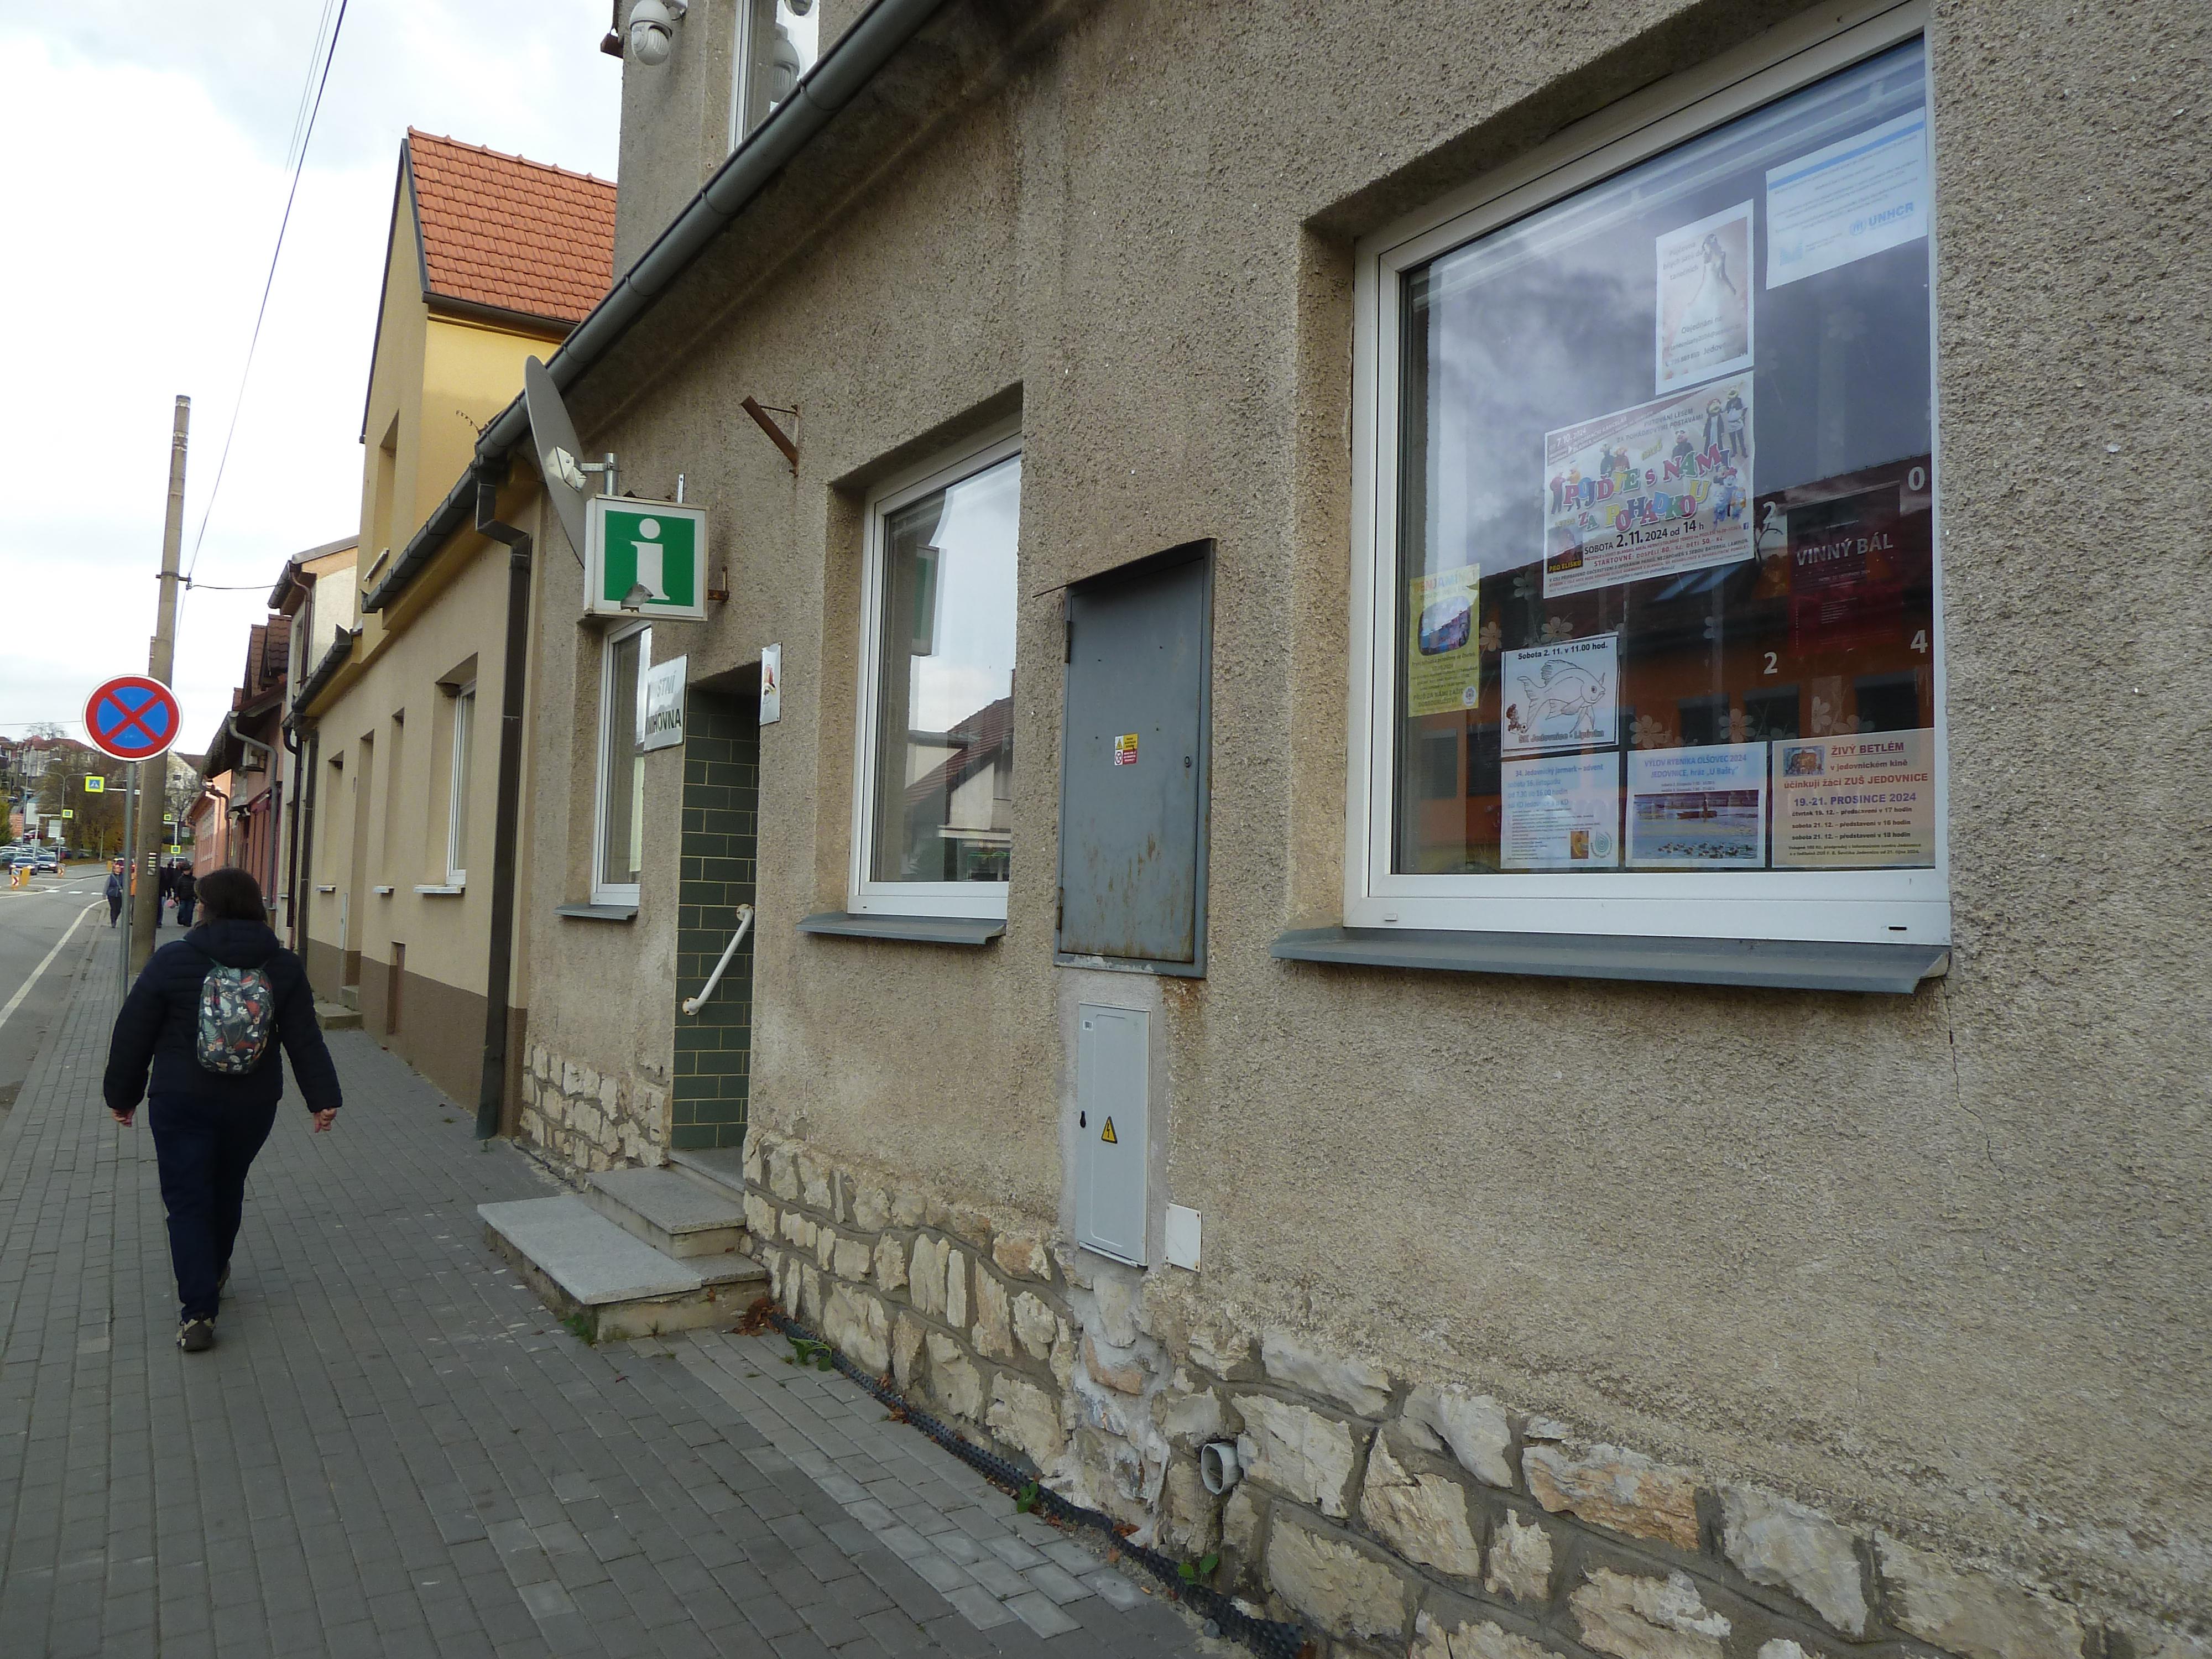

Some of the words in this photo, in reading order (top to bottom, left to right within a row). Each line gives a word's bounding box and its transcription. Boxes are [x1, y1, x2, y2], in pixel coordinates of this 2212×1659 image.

[1869, 202, 1914, 226] UNHCR
[1681, 319, 1713, 333] Objednání
[1644, 413, 1673, 427] PUTOVÁNÍ
[1674, 408, 1693, 418] LESEM
[1563, 468, 1640, 508] POJĎTE
[1907, 466, 1926, 492] 0
[1578, 510, 1599, 531] ZA
[1763, 502, 1777, 524] 2
[1584, 542, 1614, 555] SOBOTA
[1616, 530, 1643, 547] 2.11.
[1645, 528, 1668, 541] 2024
[1670, 526, 1680, 536] od
[1683, 520, 1697, 533] 14
[1699, 522, 1704, 530] h
[1796, 538, 1853, 566] VINNÝ
[1856, 531, 1894, 555] BÁL
[1548, 564, 1560, 572] PRO
[1518, 650, 1542, 660] Sobota
[1552, 648, 1563, 656] 11.
[1571, 643, 1590, 653] 11.00
[1592, 641, 1608, 650] hod.
[1910, 629, 1928, 654] 4
[1764, 651, 1778, 675] 2
[1519, 734, 1529, 743] SK
[1530, 732, 1568, 743] Jedovnice
[1831, 743, 1856, 755] ŽIVÝ
[1859, 741, 1904, 754] BETLÉM
[1644, 758, 1666, 767] VÝLOV
[1667, 757, 1695, 766] RYBNÍKA
[1697, 754, 1728, 764] OLŠOVEC
[1729, 754, 1746, 762] 2024
[1836, 760, 1887, 771] jedovnickém
[1525, 767, 1554, 776] Jedovnický
[1555, 765, 1578, 775] jarmark
[1651, 769, 1688, 779] JEDOVNICE,
[1784, 779, 1819, 789] účinkují
[1844, 775, 1864, 785] ZUŠ
[1867, 773, 1928, 784] JEDOVNICE
[1794, 796, 1827, 807] 19.-21.
[1830, 794, 1886, 805] PROSINCE
[1888, 792, 1917, 802] 2024
